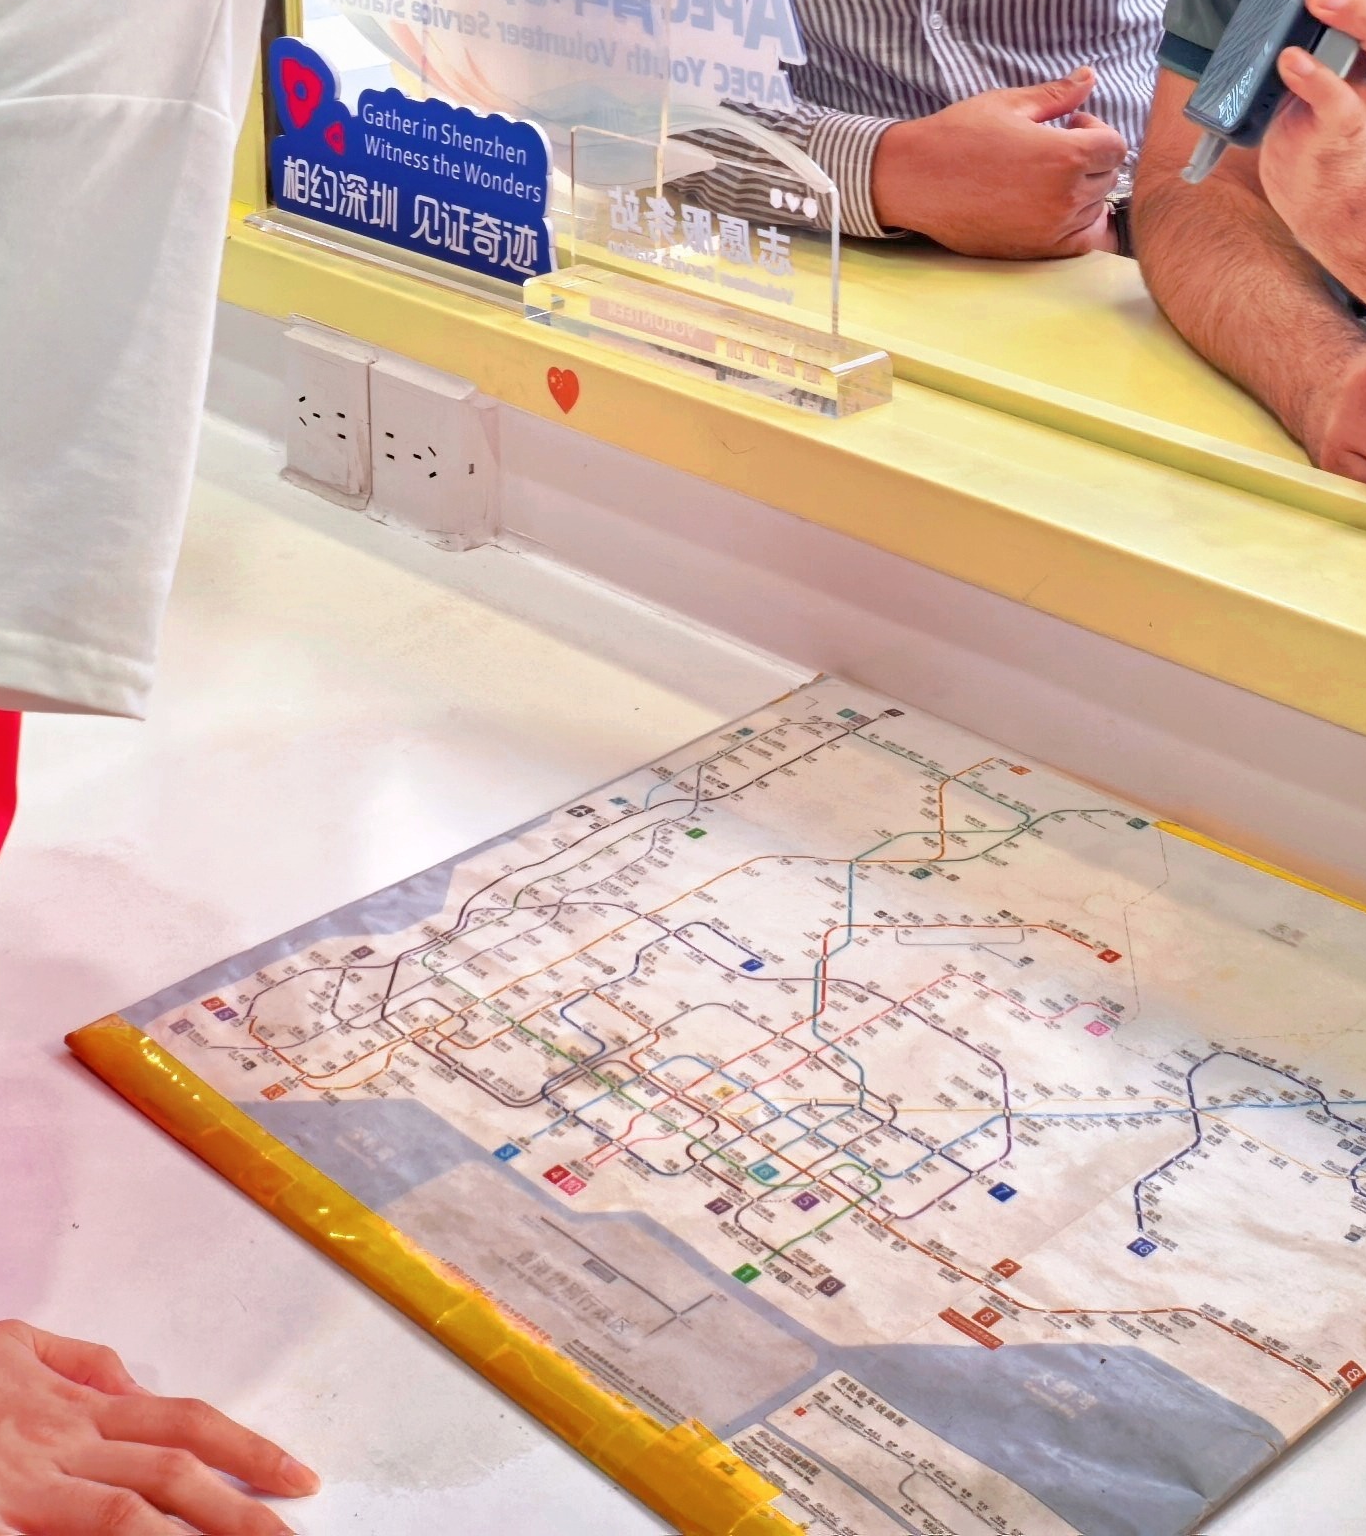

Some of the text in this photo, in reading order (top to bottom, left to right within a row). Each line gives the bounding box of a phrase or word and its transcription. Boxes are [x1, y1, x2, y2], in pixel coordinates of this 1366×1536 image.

[362, 103, 527, 166] Gather in Shenzhen
[364, 133, 542, 204] Witness the Wonders
[282, 155, 539, 276] 相约深圳 见证奇迹
